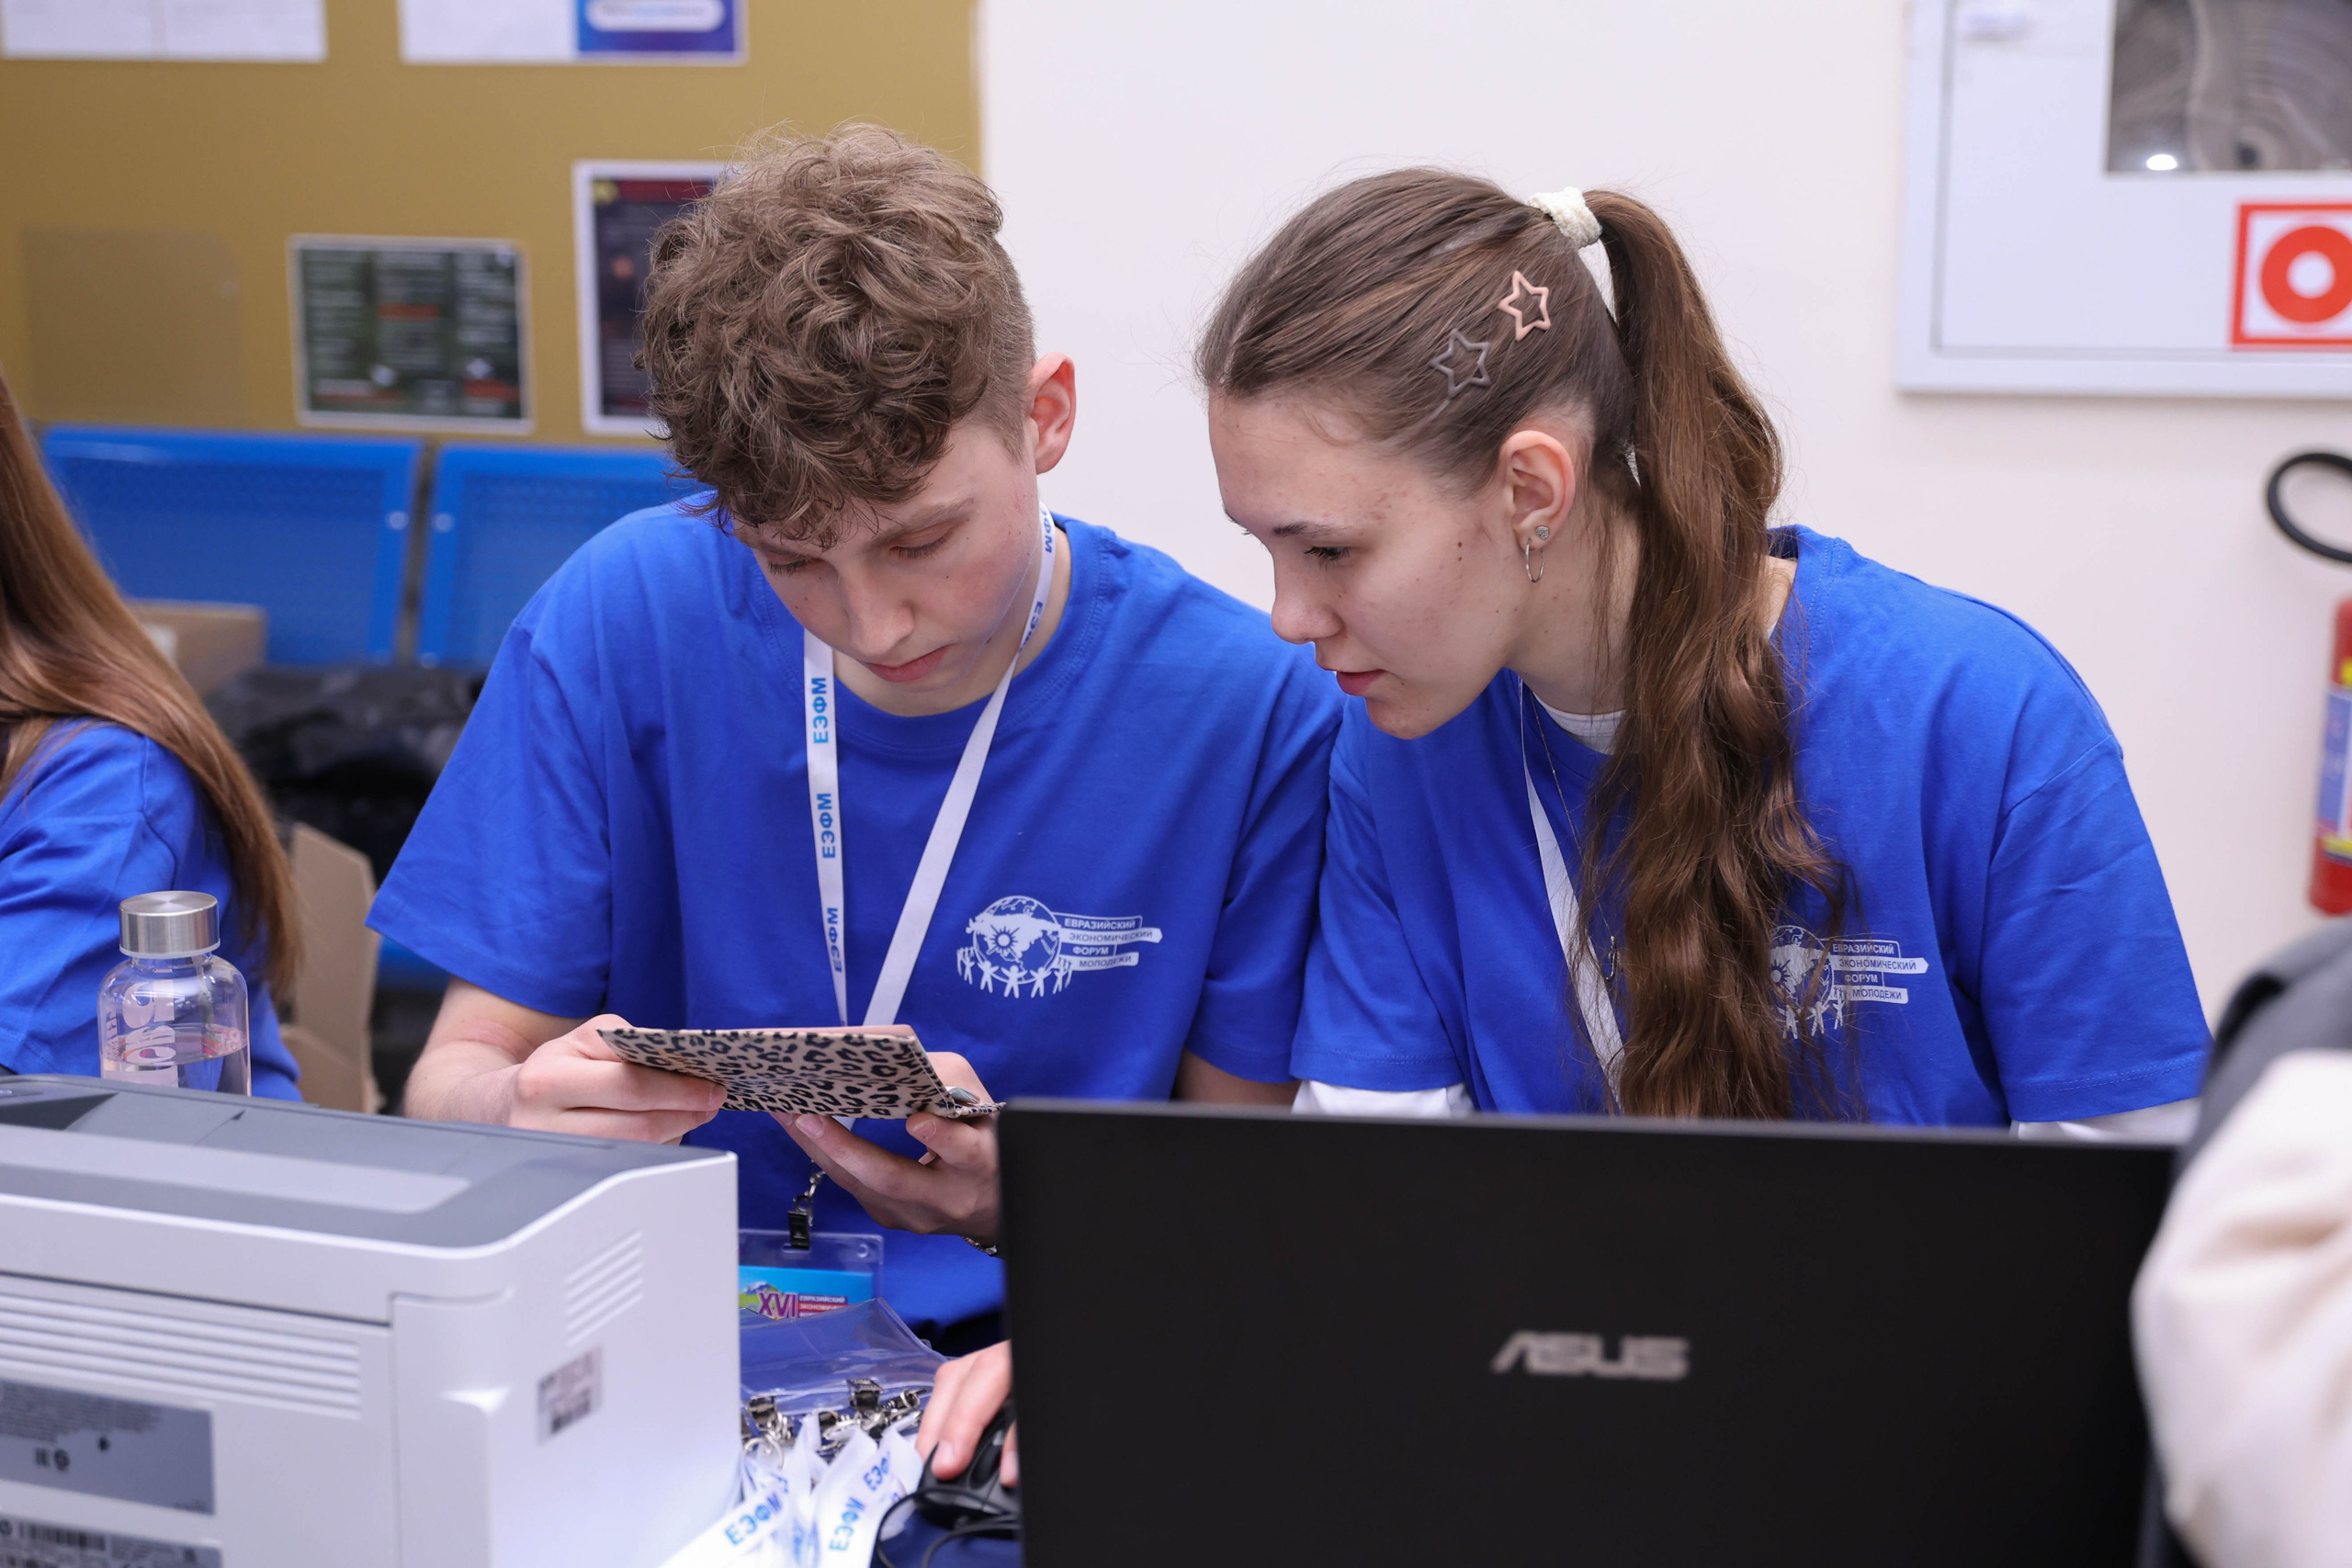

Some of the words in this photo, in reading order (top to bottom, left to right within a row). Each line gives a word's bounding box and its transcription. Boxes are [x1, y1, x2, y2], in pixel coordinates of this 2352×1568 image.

[811, 677, 829, 743] ЕЭФМ
[817, 793, 836, 859] ЕЭФМ
[1064, 918, 1136, 930] ЕВРАЗИЙСКИЙ
[827, 908, 842, 973] ЕЭФМ
[1069, 930, 1153, 942] ЭКОНОМИЧЕСКИЙ
[1072, 946, 1109, 956] ФОРУМ
[1833, 943, 1894, 954] ЕВРАЗИЙСКИЙ
[1080, 956, 1132, 968] МОЛОДЕЖИ
[1839, 959, 1917, 970] ЭКОНОМИЧЕСКИЙ
[1844, 974, 1879, 984] ФОРУМ
[1852, 988, 1902, 1000] МОЛОДЕЖИ
[758, 1292, 797, 1318] XVI
[1491, 1330, 1690, 1380] ASUS
[725, 1491, 781, 1546] ЕЭФМ
[829, 1496, 865, 1551] ЕЭФМ
